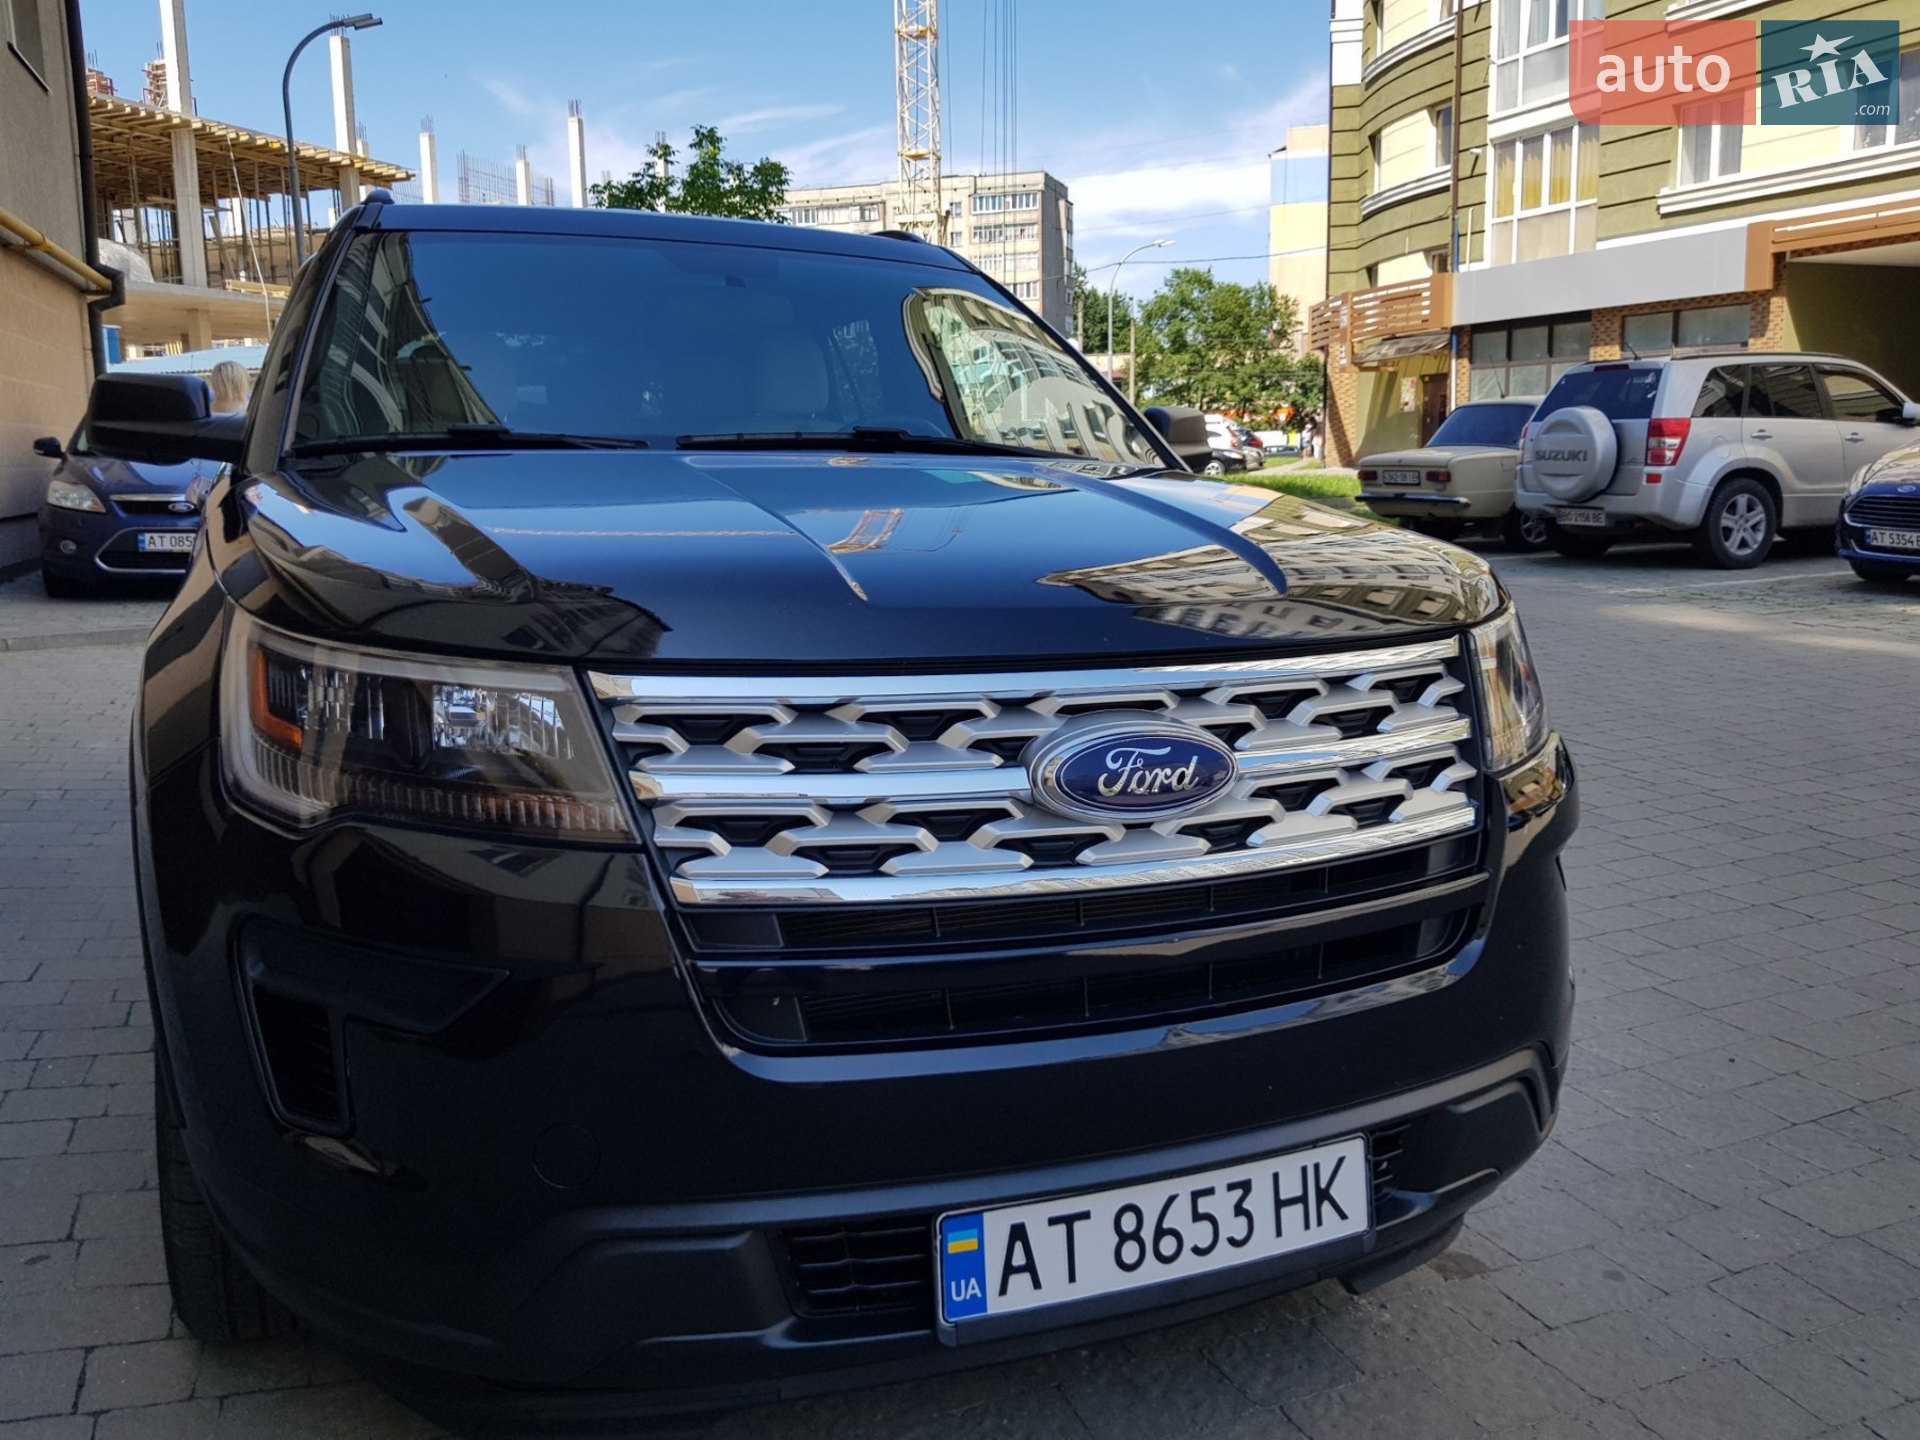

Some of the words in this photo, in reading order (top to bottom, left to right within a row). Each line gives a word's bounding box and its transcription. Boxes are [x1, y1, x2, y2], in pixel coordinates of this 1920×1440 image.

[1536, 450, 1588, 461] SUZUKI
[148, 535, 167, 547] AT
[169, 535, 196, 548] 085
[1872, 531, 1886, 544] AT
[1889, 533, 1914, 547] 5354
[1097, 746, 1200, 797] Ford
[997, 1209, 1092, 1297] AT
[1112, 1177, 1255, 1273] 8653
[1271, 1155, 1350, 1239] HK
[950, 1277, 982, 1302] UA
